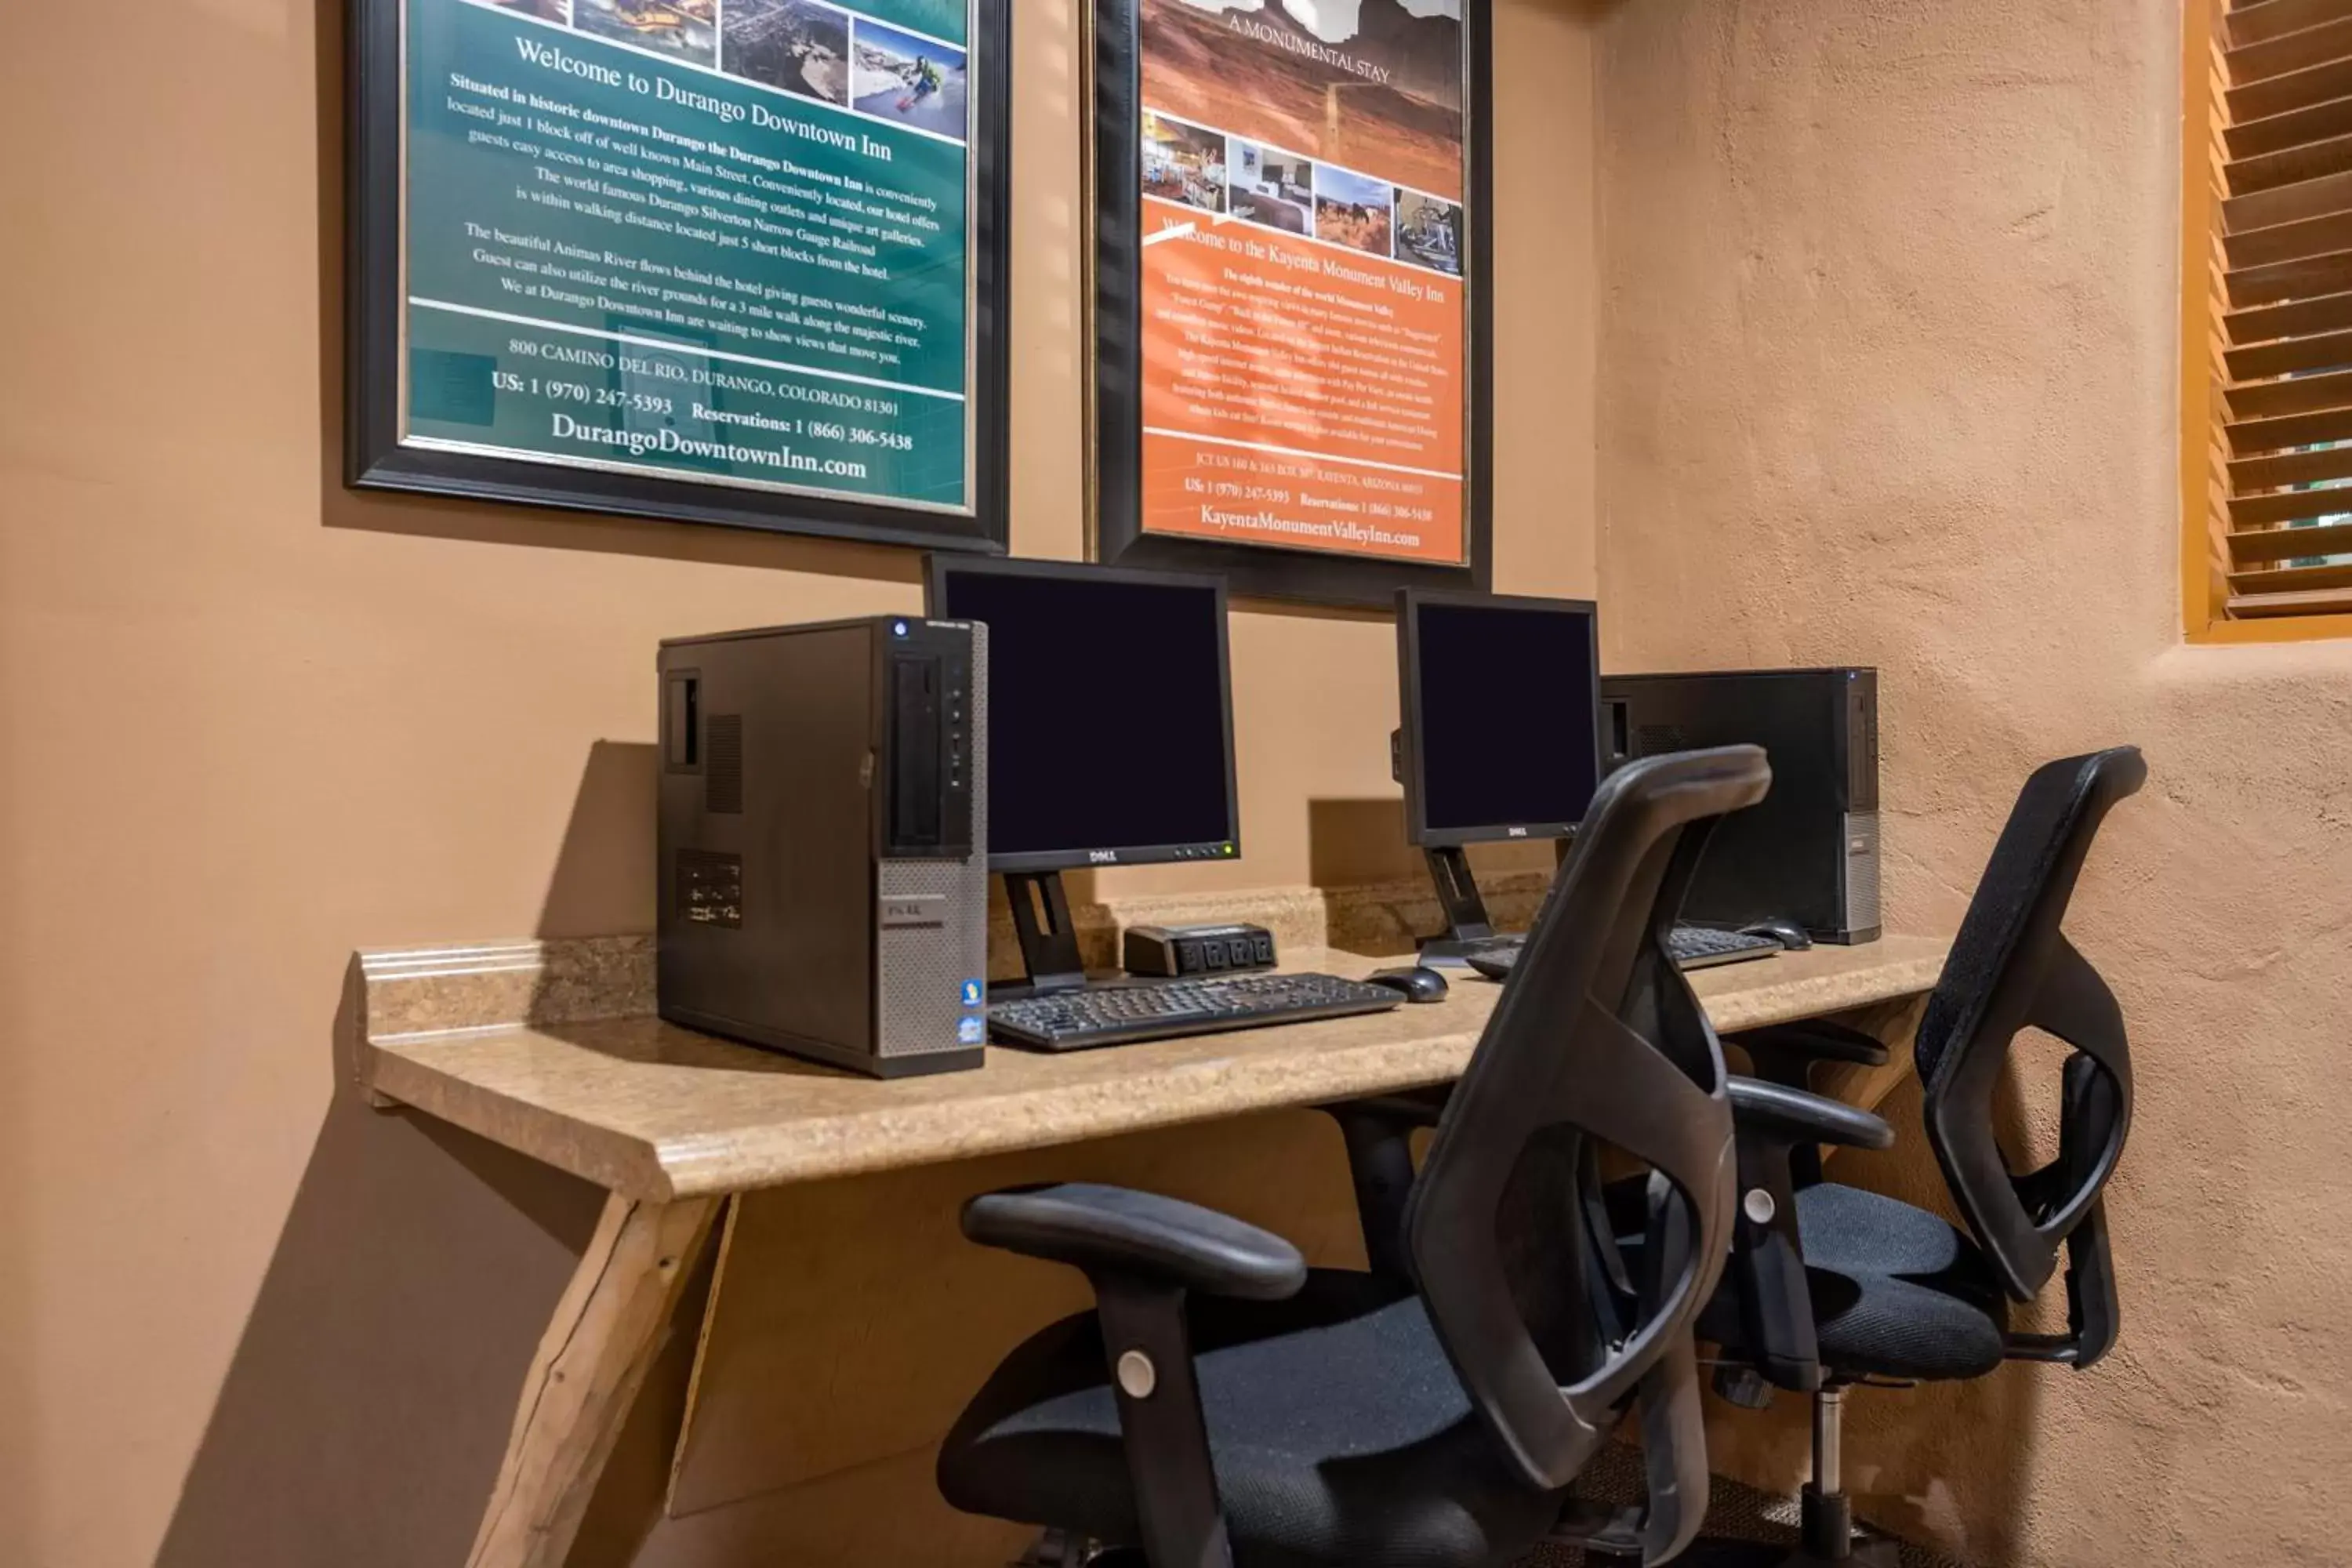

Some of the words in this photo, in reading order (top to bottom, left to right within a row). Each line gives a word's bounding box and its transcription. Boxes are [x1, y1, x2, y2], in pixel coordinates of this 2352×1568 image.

[1229, 14, 1241, 33] A
[1244, 19, 1354, 71] MONUMENTAL
[1357, 60, 1390, 83] STAY
[516, 37, 620, 86] Welcome
[629, 73, 648, 94] to
[656, 76, 745, 122] Durango
[752, 103, 855, 151] Downtown
[862, 134, 892, 161] Inn
[447, 96, 494, 120] located
[497, 112, 521, 126] just
[527, 117, 532, 129] 1
[537, 118, 570, 139] block
[574, 131, 592, 144] off
[595, 136, 608, 148] of
[612, 141, 637, 155] well
[641, 145, 680, 166] known
[683, 156, 712, 175] Main
[866, 205, 884, 216] our
[885, 207, 910, 223] hotel
[451, 73, 508, 100] Situated
[513, 89, 525, 103] in
[529, 93, 579, 118] historic
[583, 108, 648, 136] downtown
[652, 125, 706, 151] Durango
[708, 141, 727, 156] the
[729, 146, 780, 170] Durango
[782, 160, 841, 186] Downtown
[844, 176, 862, 191] Inn
[876, 187, 936, 212] conveniently
[464, 222, 488, 239] The
[495, 227, 550, 251] beautiful
[554, 241, 601, 262] Animas
[604, 250, 637, 269] River
[640, 259, 670, 276] flows
[673, 265, 713, 285] behind
[714, 275, 732, 289] the
[734, 278, 762, 295] hotel
[764, 285, 797, 305] giving
[800, 295, 833, 309] guests
[834, 302, 885, 320] wonderful
[531, 191, 570, 209] within
[574, 201, 622, 223] walking
[624, 211, 673, 232] distance
[676, 221, 716, 241] located
[717, 232, 739, 246] just
[741, 236, 749, 248] 5
[751, 240, 778, 255] short
[780, 245, 815, 263] blocks
[817, 253, 842, 270] from
[844, 260, 860, 273] the
[1228, 238, 1242, 253] to
[1245, 240, 1265, 259] the
[1269, 244, 1319, 272] Kayenta
[1323, 258, 1385, 288] Monument
[1389, 275, 1422, 300] Valley
[1426, 285, 1444, 302] Inn
[473, 248, 510, 267] Guest
[515, 260, 536, 272] can
[540, 262, 565, 277] also
[569, 269, 606, 286] utilize
[610, 275, 628, 290] the
[631, 281, 659, 296] river
[662, 289, 707, 305] grounds
[710, 296, 726, 309] for
[728, 302, 735, 311] a
[739, 301, 746, 313] 3
[749, 305, 772, 318] mile
[775, 310, 800, 324] walk
[803, 314, 832, 332] along
[833, 321, 850, 334] the
[492, 371, 523, 391] US:
[531, 378, 538, 394] 1
[546, 380, 590, 403] (970)
[596, 388, 671, 414] 247-5393
[692, 402, 790, 431] Reservations:
[795, 419, 802, 434] 1
[808, 421, 844, 441] (866)
[850, 427, 913, 450] 306-5438
[509, 339, 536, 356] 800
[541, 343, 614, 368] CAMINO
[619, 355, 646, 375] DEL
[655, 362, 688, 382] RIO,
[692, 368, 775, 396] DURANGO,
[779, 383, 861, 408] COLORADO
[864, 398, 898, 416] 81301
[551, 413, 866, 477] DurangoDowntownInn.com
[1201, 504, 1419, 546] KayentaMonumentValleyInn.com
[1090, 851, 1117, 862] DELL
